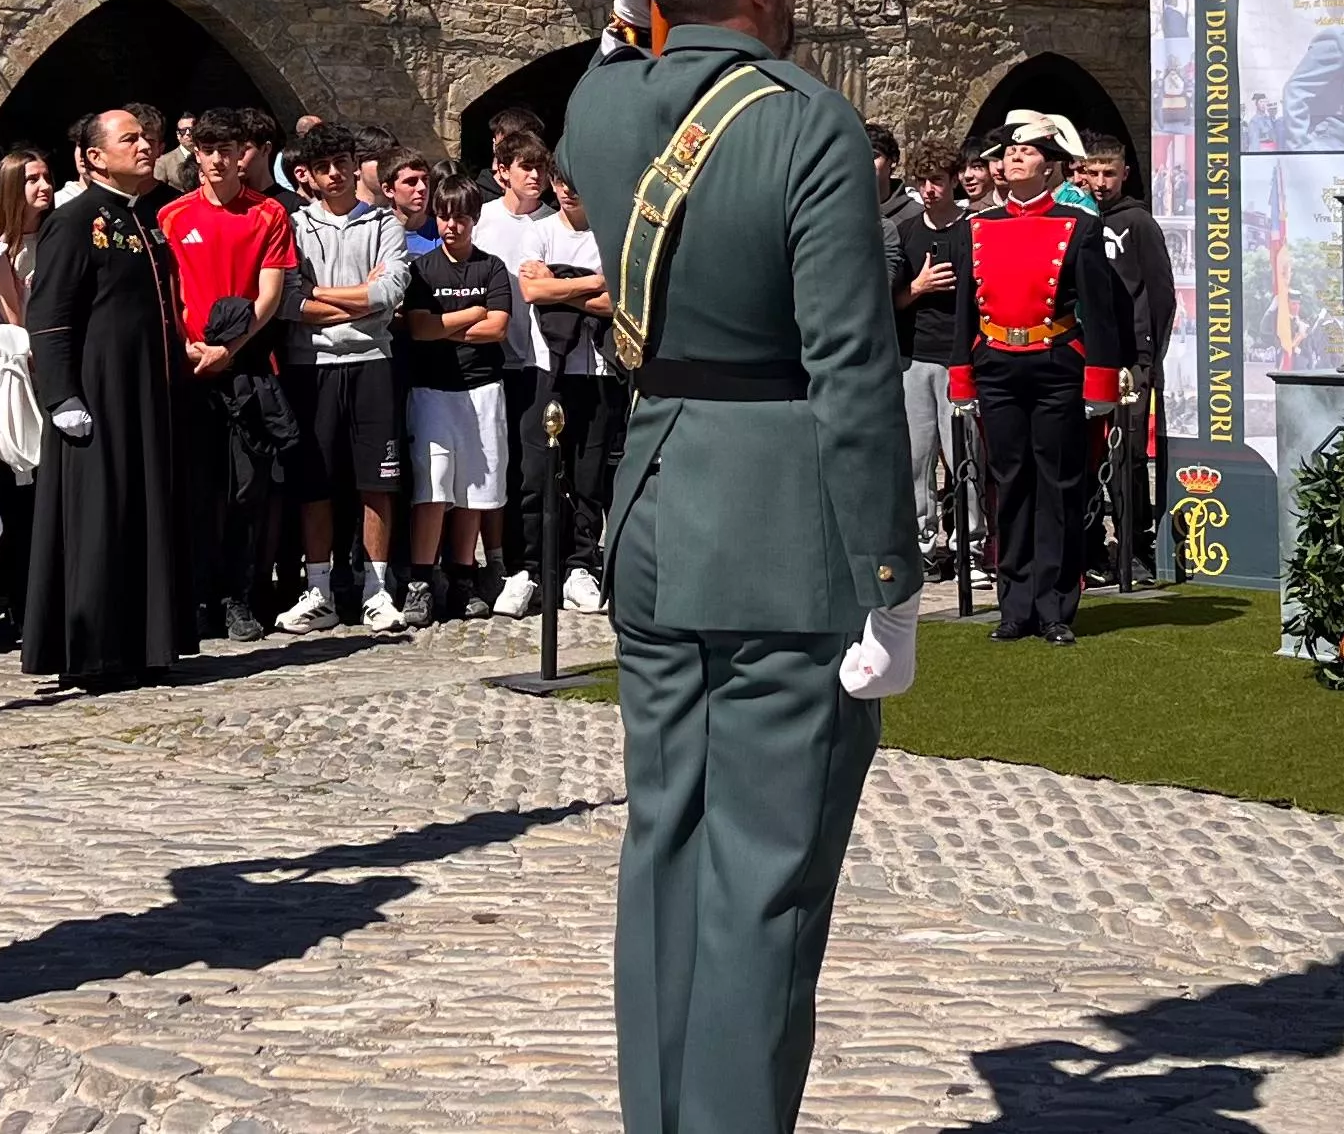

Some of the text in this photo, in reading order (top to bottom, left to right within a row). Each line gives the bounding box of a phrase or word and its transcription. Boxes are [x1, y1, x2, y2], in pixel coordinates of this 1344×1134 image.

[1205, 9, 1229, 144] DECORUM
[1206, 152, 1230, 200] EST
[1207, 206, 1231, 261] PRO
[1207, 268, 1231, 363] PATRIA
[1208, 369, 1233, 443] MORI
